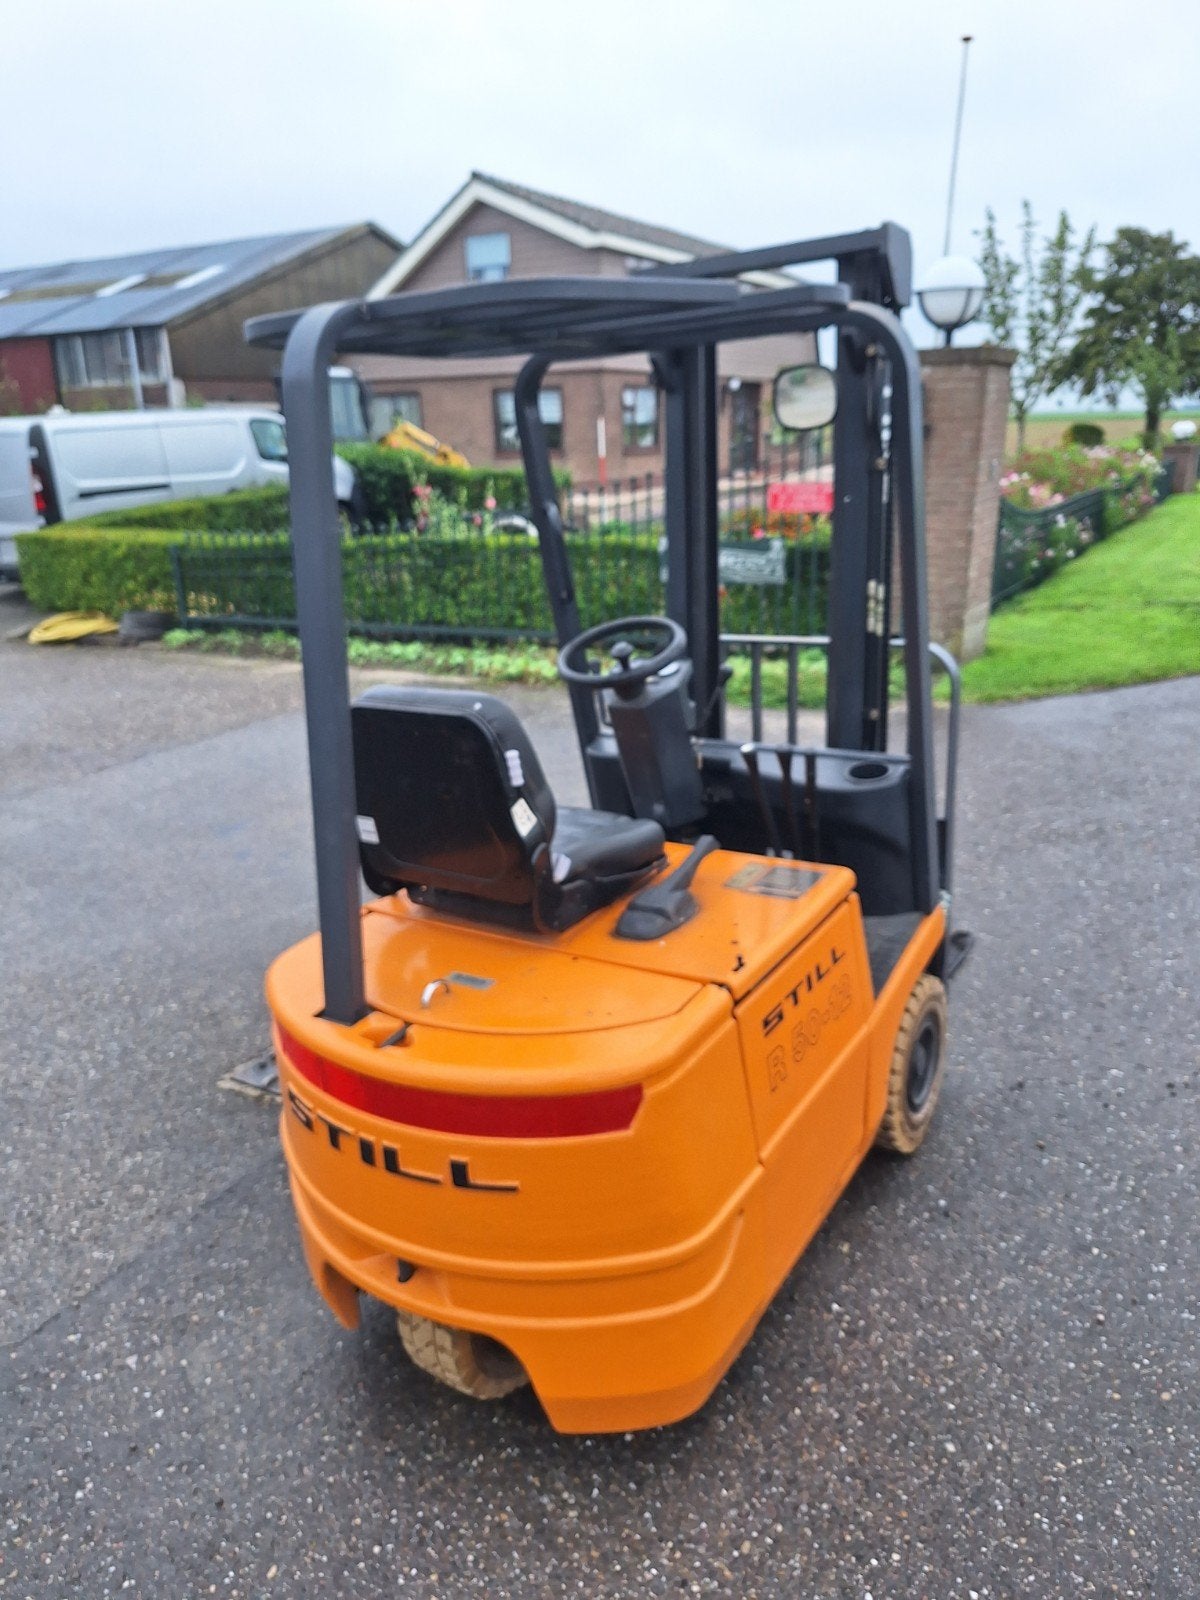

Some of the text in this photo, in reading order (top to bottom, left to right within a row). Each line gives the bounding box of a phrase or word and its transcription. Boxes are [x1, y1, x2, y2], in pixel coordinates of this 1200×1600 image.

[762, 946, 846, 1038] STILL
[766, 1044, 788, 1094] R
[287, 1082, 519, 1193] STILL
